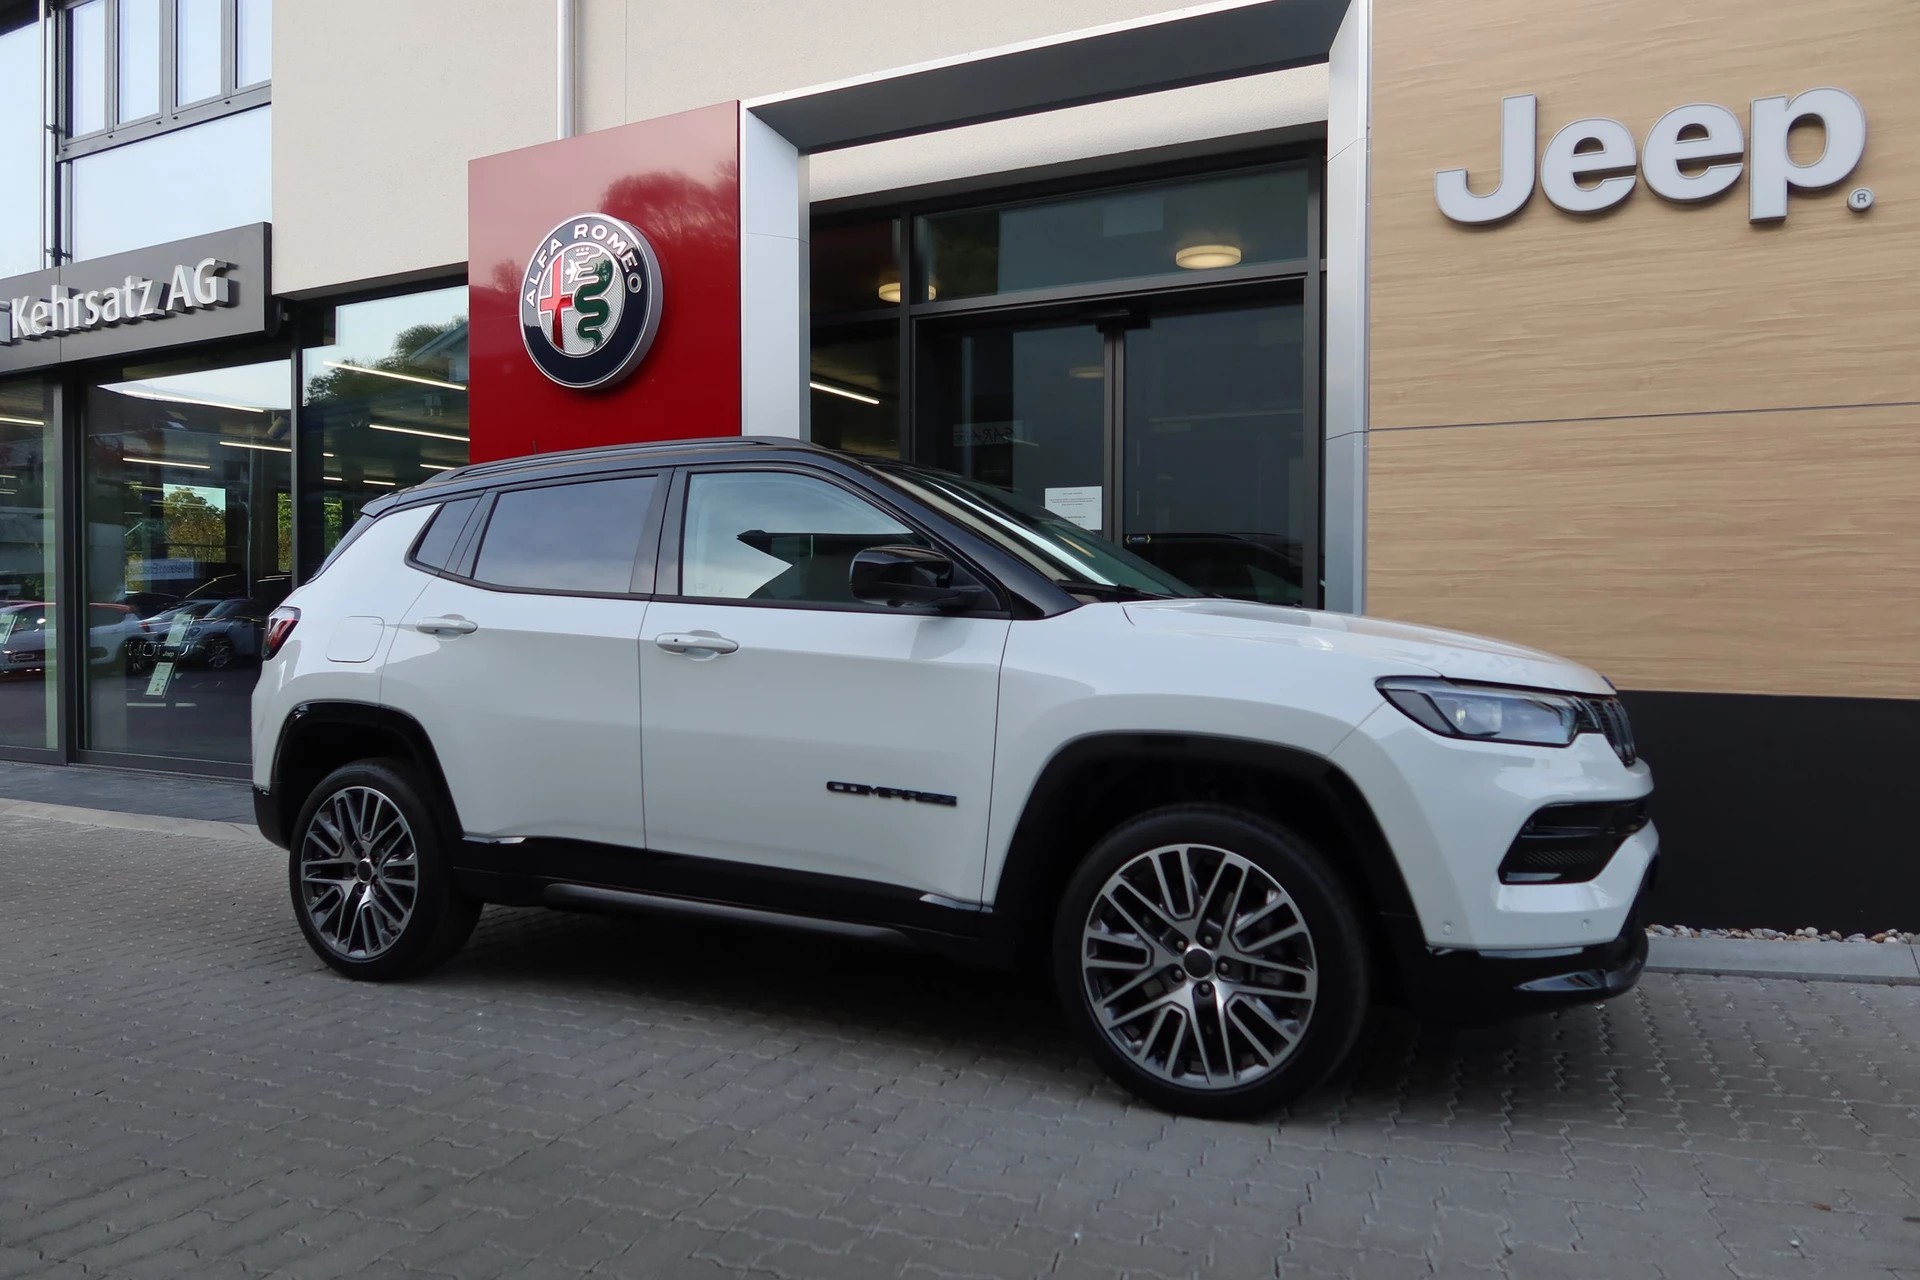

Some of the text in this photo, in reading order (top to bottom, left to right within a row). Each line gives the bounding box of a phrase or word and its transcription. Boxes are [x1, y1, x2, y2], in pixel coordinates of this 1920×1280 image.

[1434, 87, 1867, 223] Jeep
[12, 275, 160, 338] Kehrsatz
[166, 258, 229, 311] AG
[526, 224, 642, 307] ALFA ROMEO
